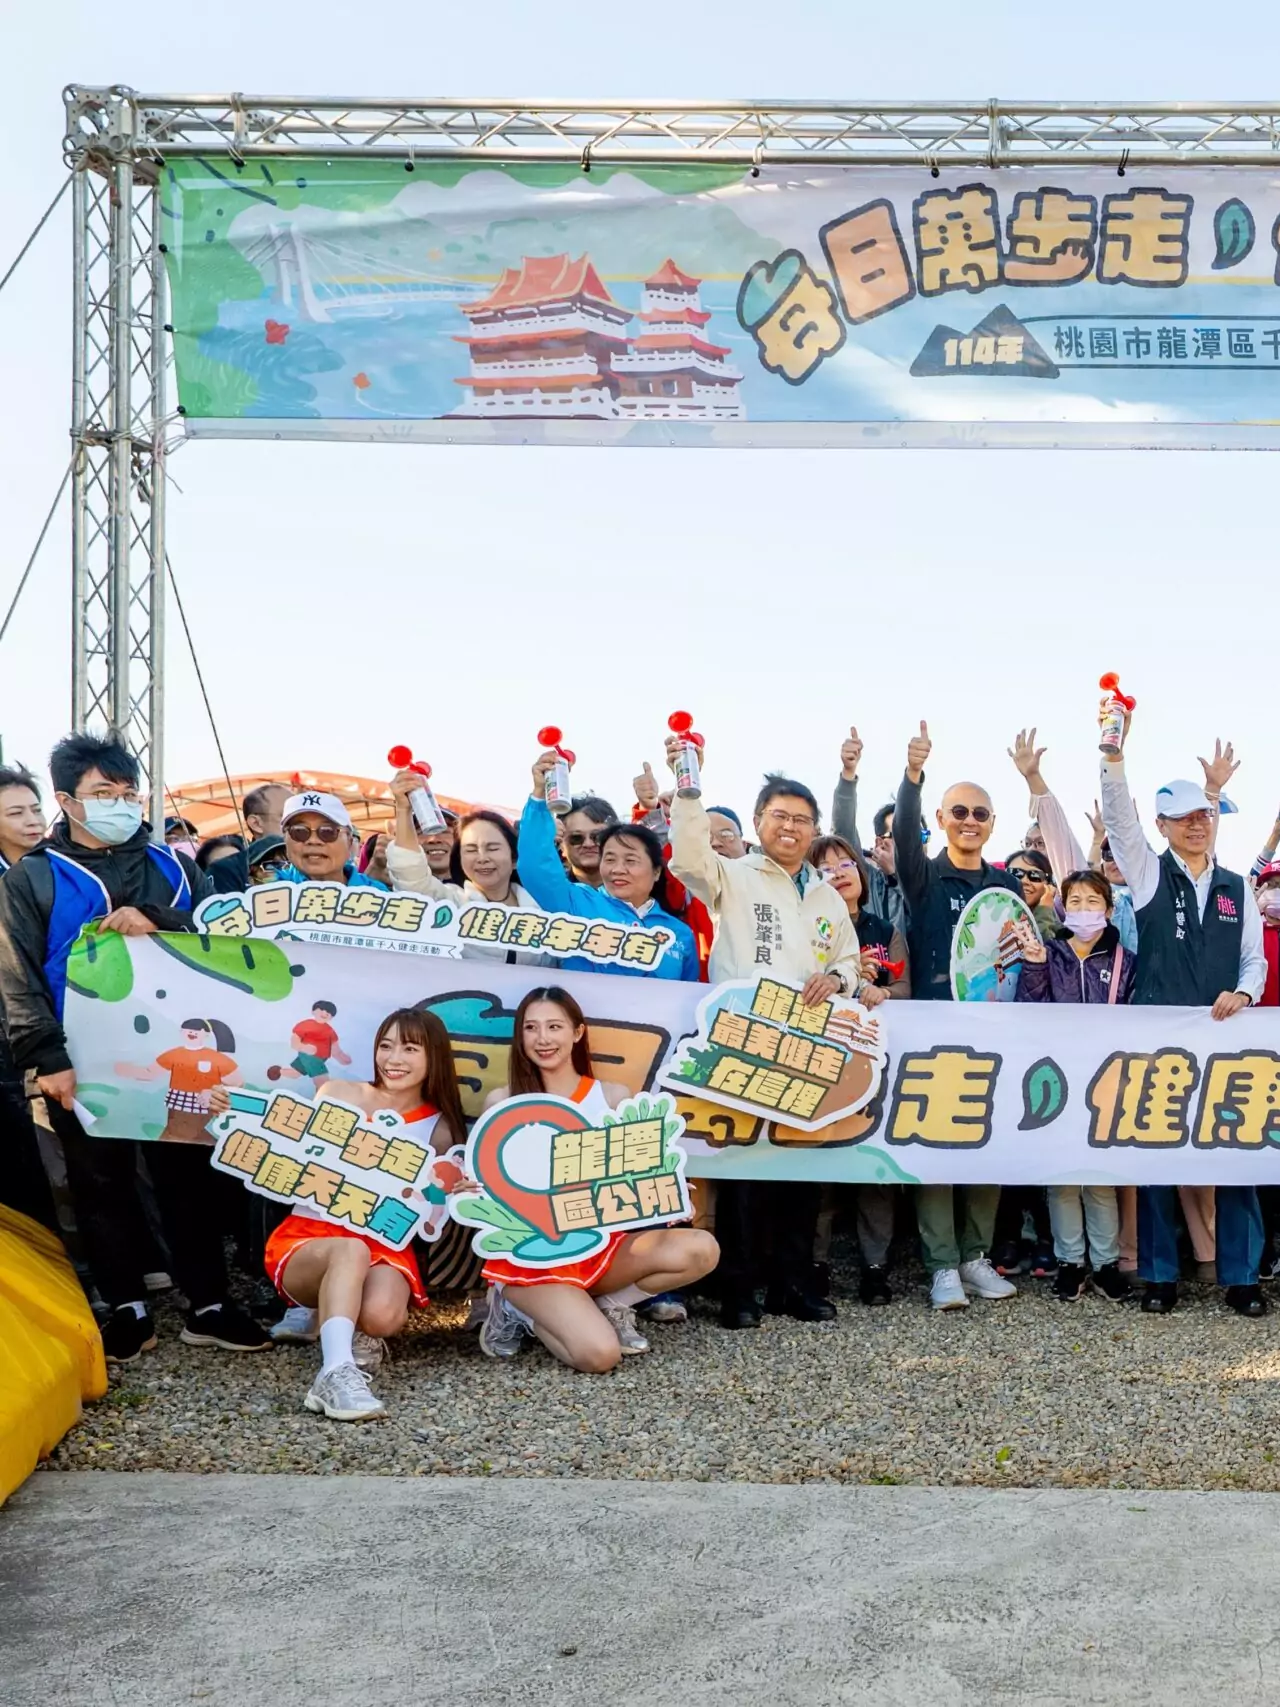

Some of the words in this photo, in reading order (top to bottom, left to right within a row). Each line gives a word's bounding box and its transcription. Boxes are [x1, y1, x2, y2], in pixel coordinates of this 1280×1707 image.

[943, 335, 1025, 367] 114年
[707, 1007, 849, 1084] 最美健走
[551, 1116, 666, 1188] 龍潭
[549, 1171, 685, 1235] 區公所
